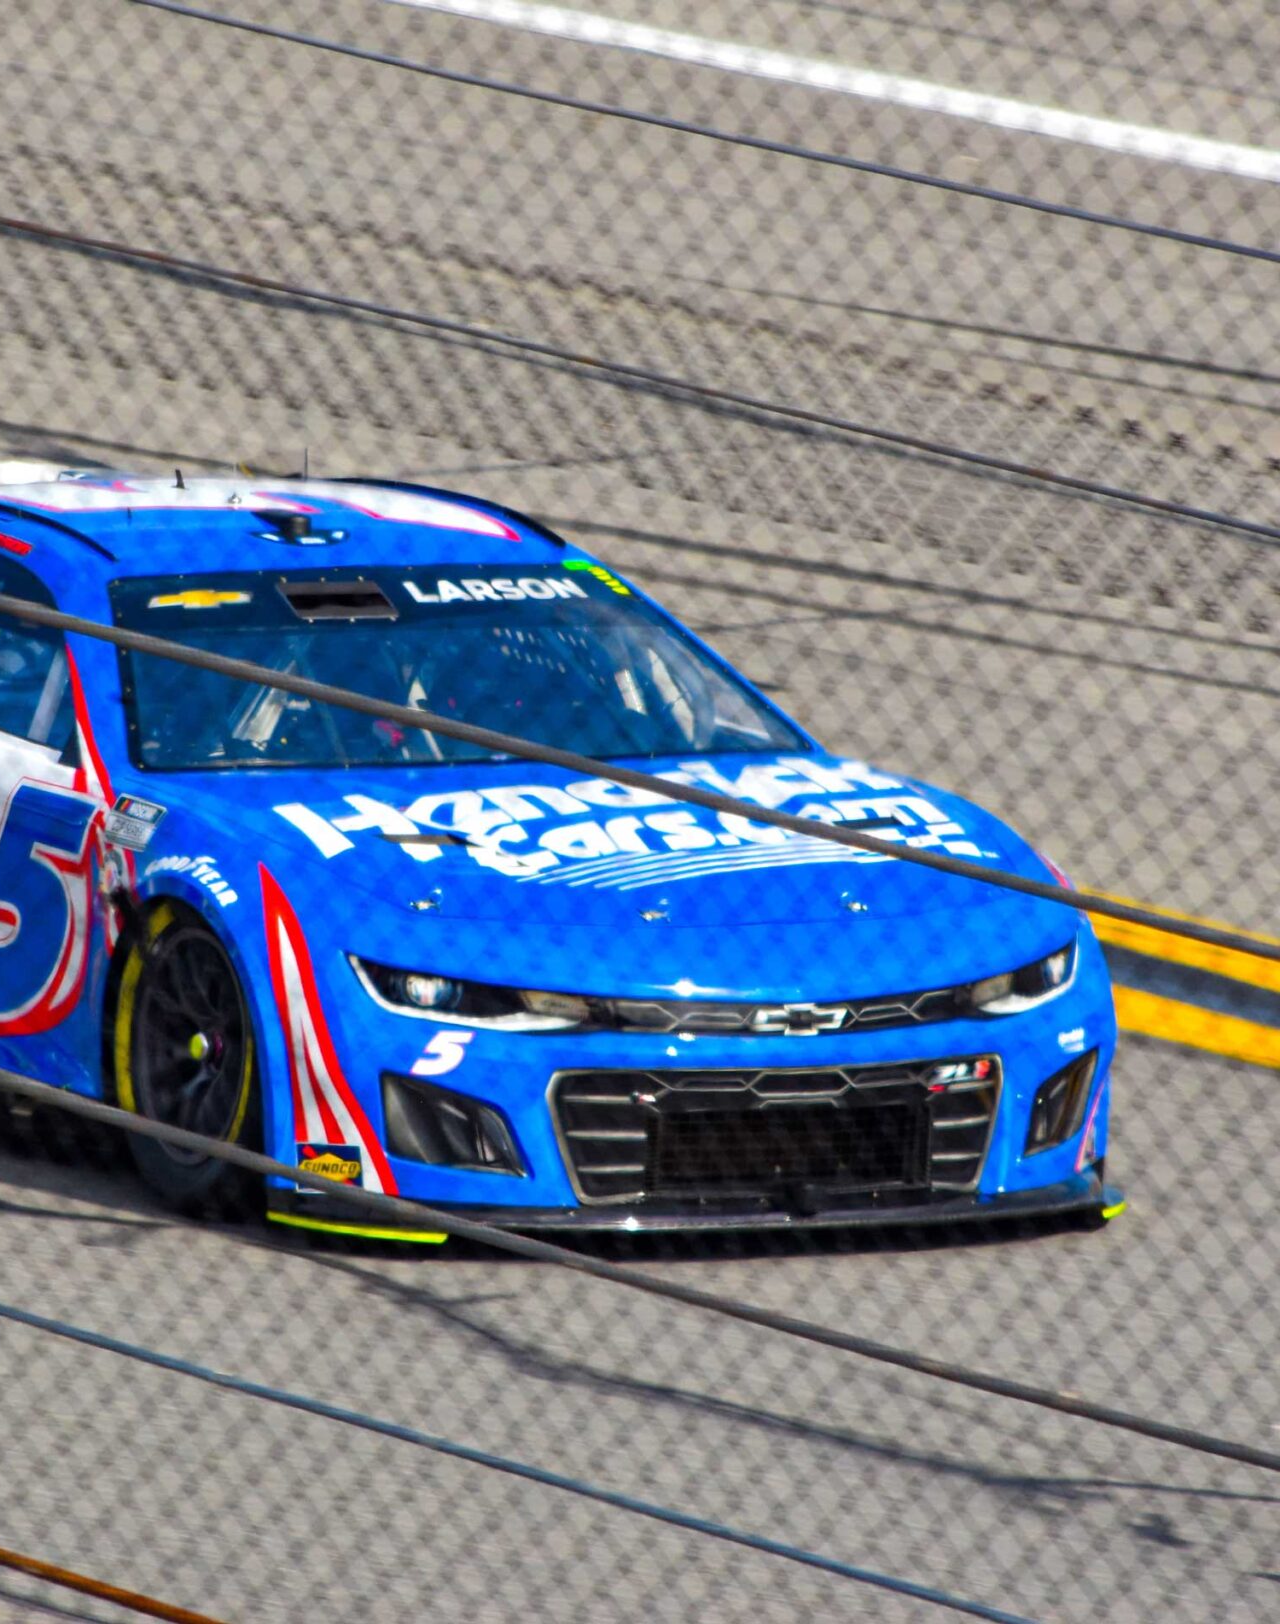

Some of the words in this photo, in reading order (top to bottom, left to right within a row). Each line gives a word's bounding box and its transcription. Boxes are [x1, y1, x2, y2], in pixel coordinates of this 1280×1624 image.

[402, 577, 589, 603] LARSON
[410, 1030, 476, 1076] 5
[303, 1160, 358, 1175] SUNOCO
